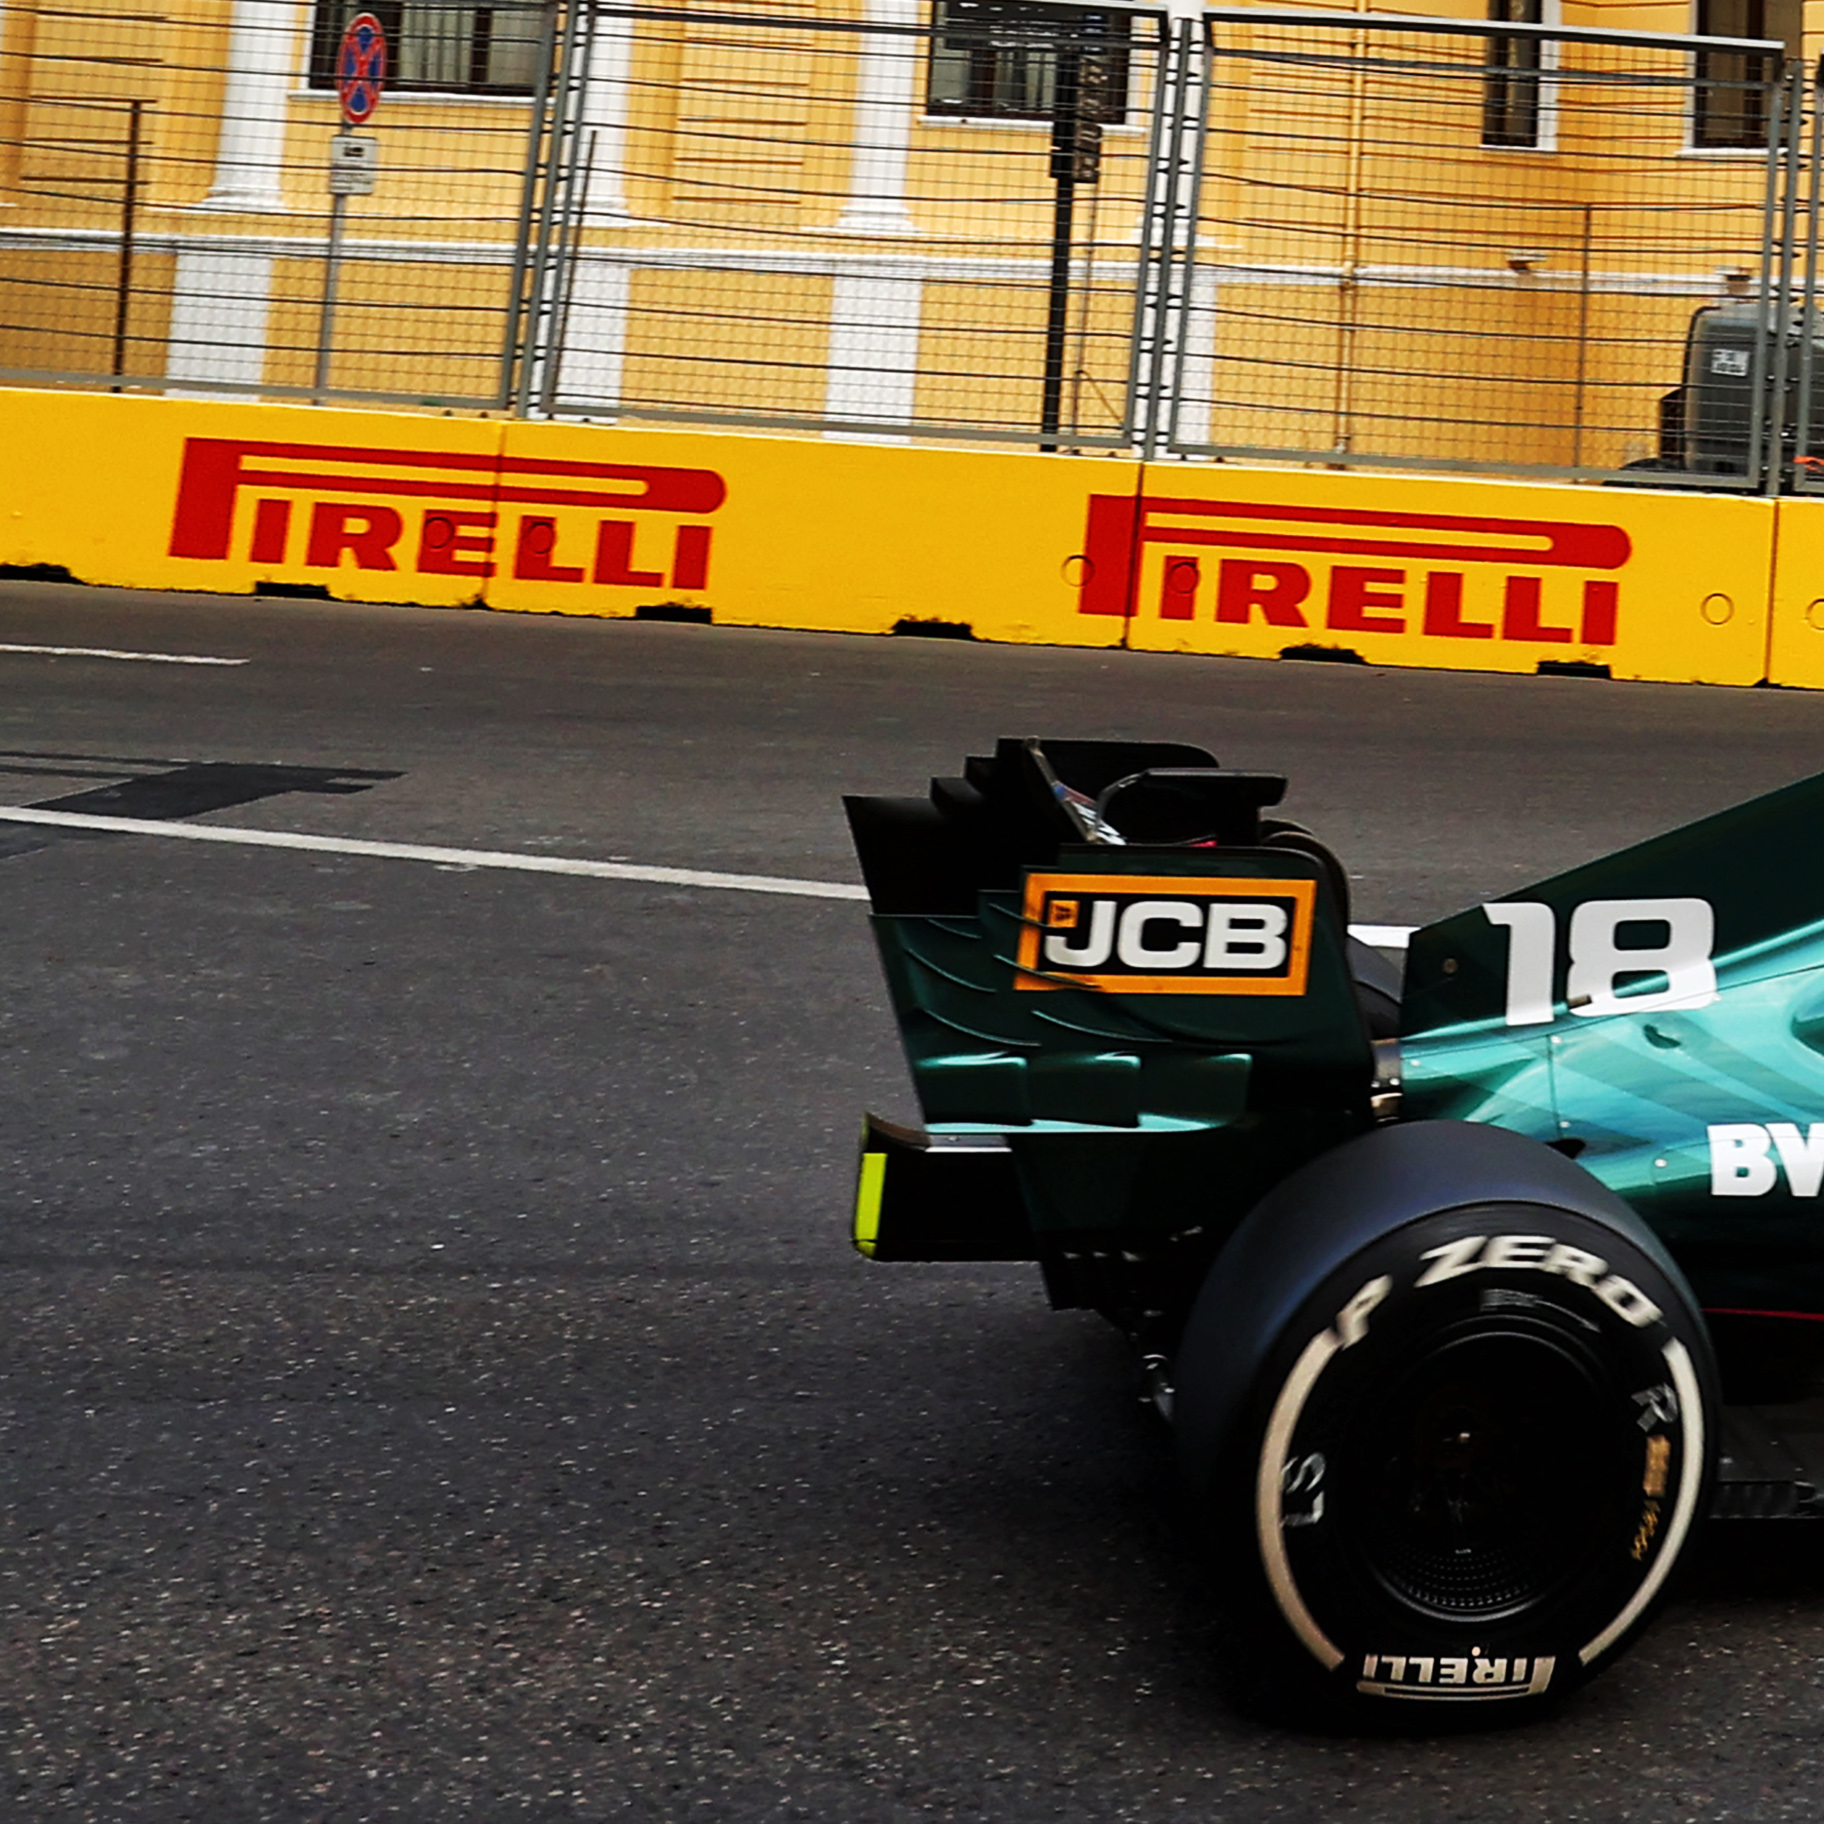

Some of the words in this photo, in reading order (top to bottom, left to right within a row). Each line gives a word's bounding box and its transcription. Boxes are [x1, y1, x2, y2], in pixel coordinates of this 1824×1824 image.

[170, 438, 727, 590] PIRELLI
[1078, 494, 1632, 646] PIRELLI
[1044, 900, 1288, 969] JCB
[1485, 898, 1716, 1026] 18
[1414, 1235, 1664, 1328] ZERO
[1355, 1654, 1556, 1702] PIRELLI
